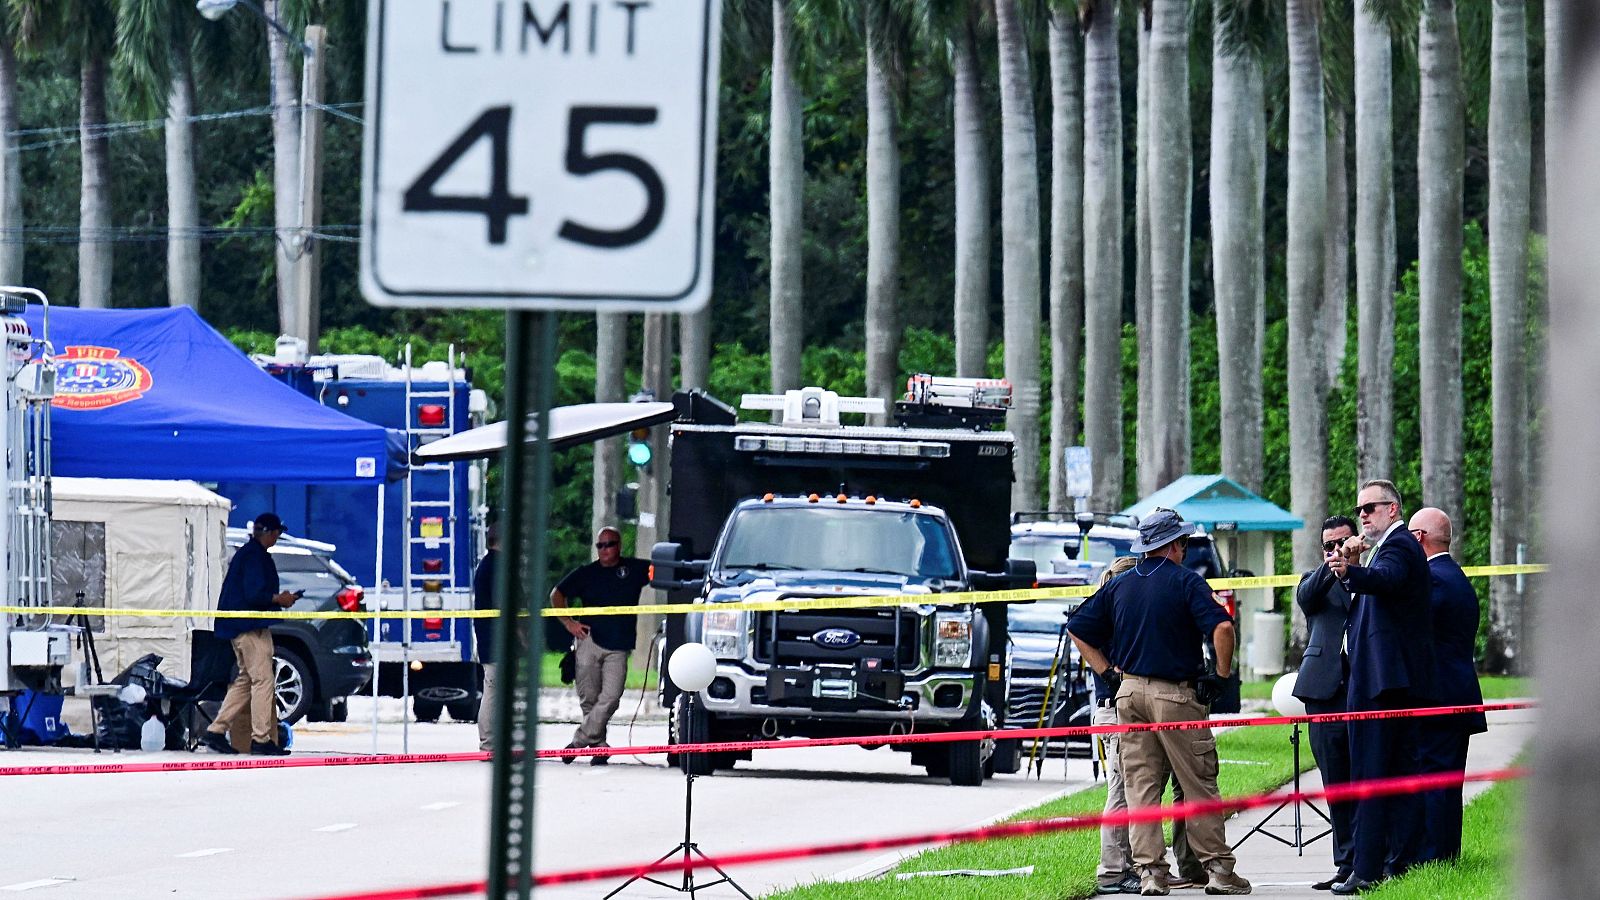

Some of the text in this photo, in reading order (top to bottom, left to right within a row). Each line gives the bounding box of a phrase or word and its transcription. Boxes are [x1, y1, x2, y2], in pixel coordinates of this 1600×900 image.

[440, 0, 655, 56] LIMIT
[401, 104, 667, 250] 45
[77, 348, 106, 358] FBI
[824, 632, 850, 644] Ford
